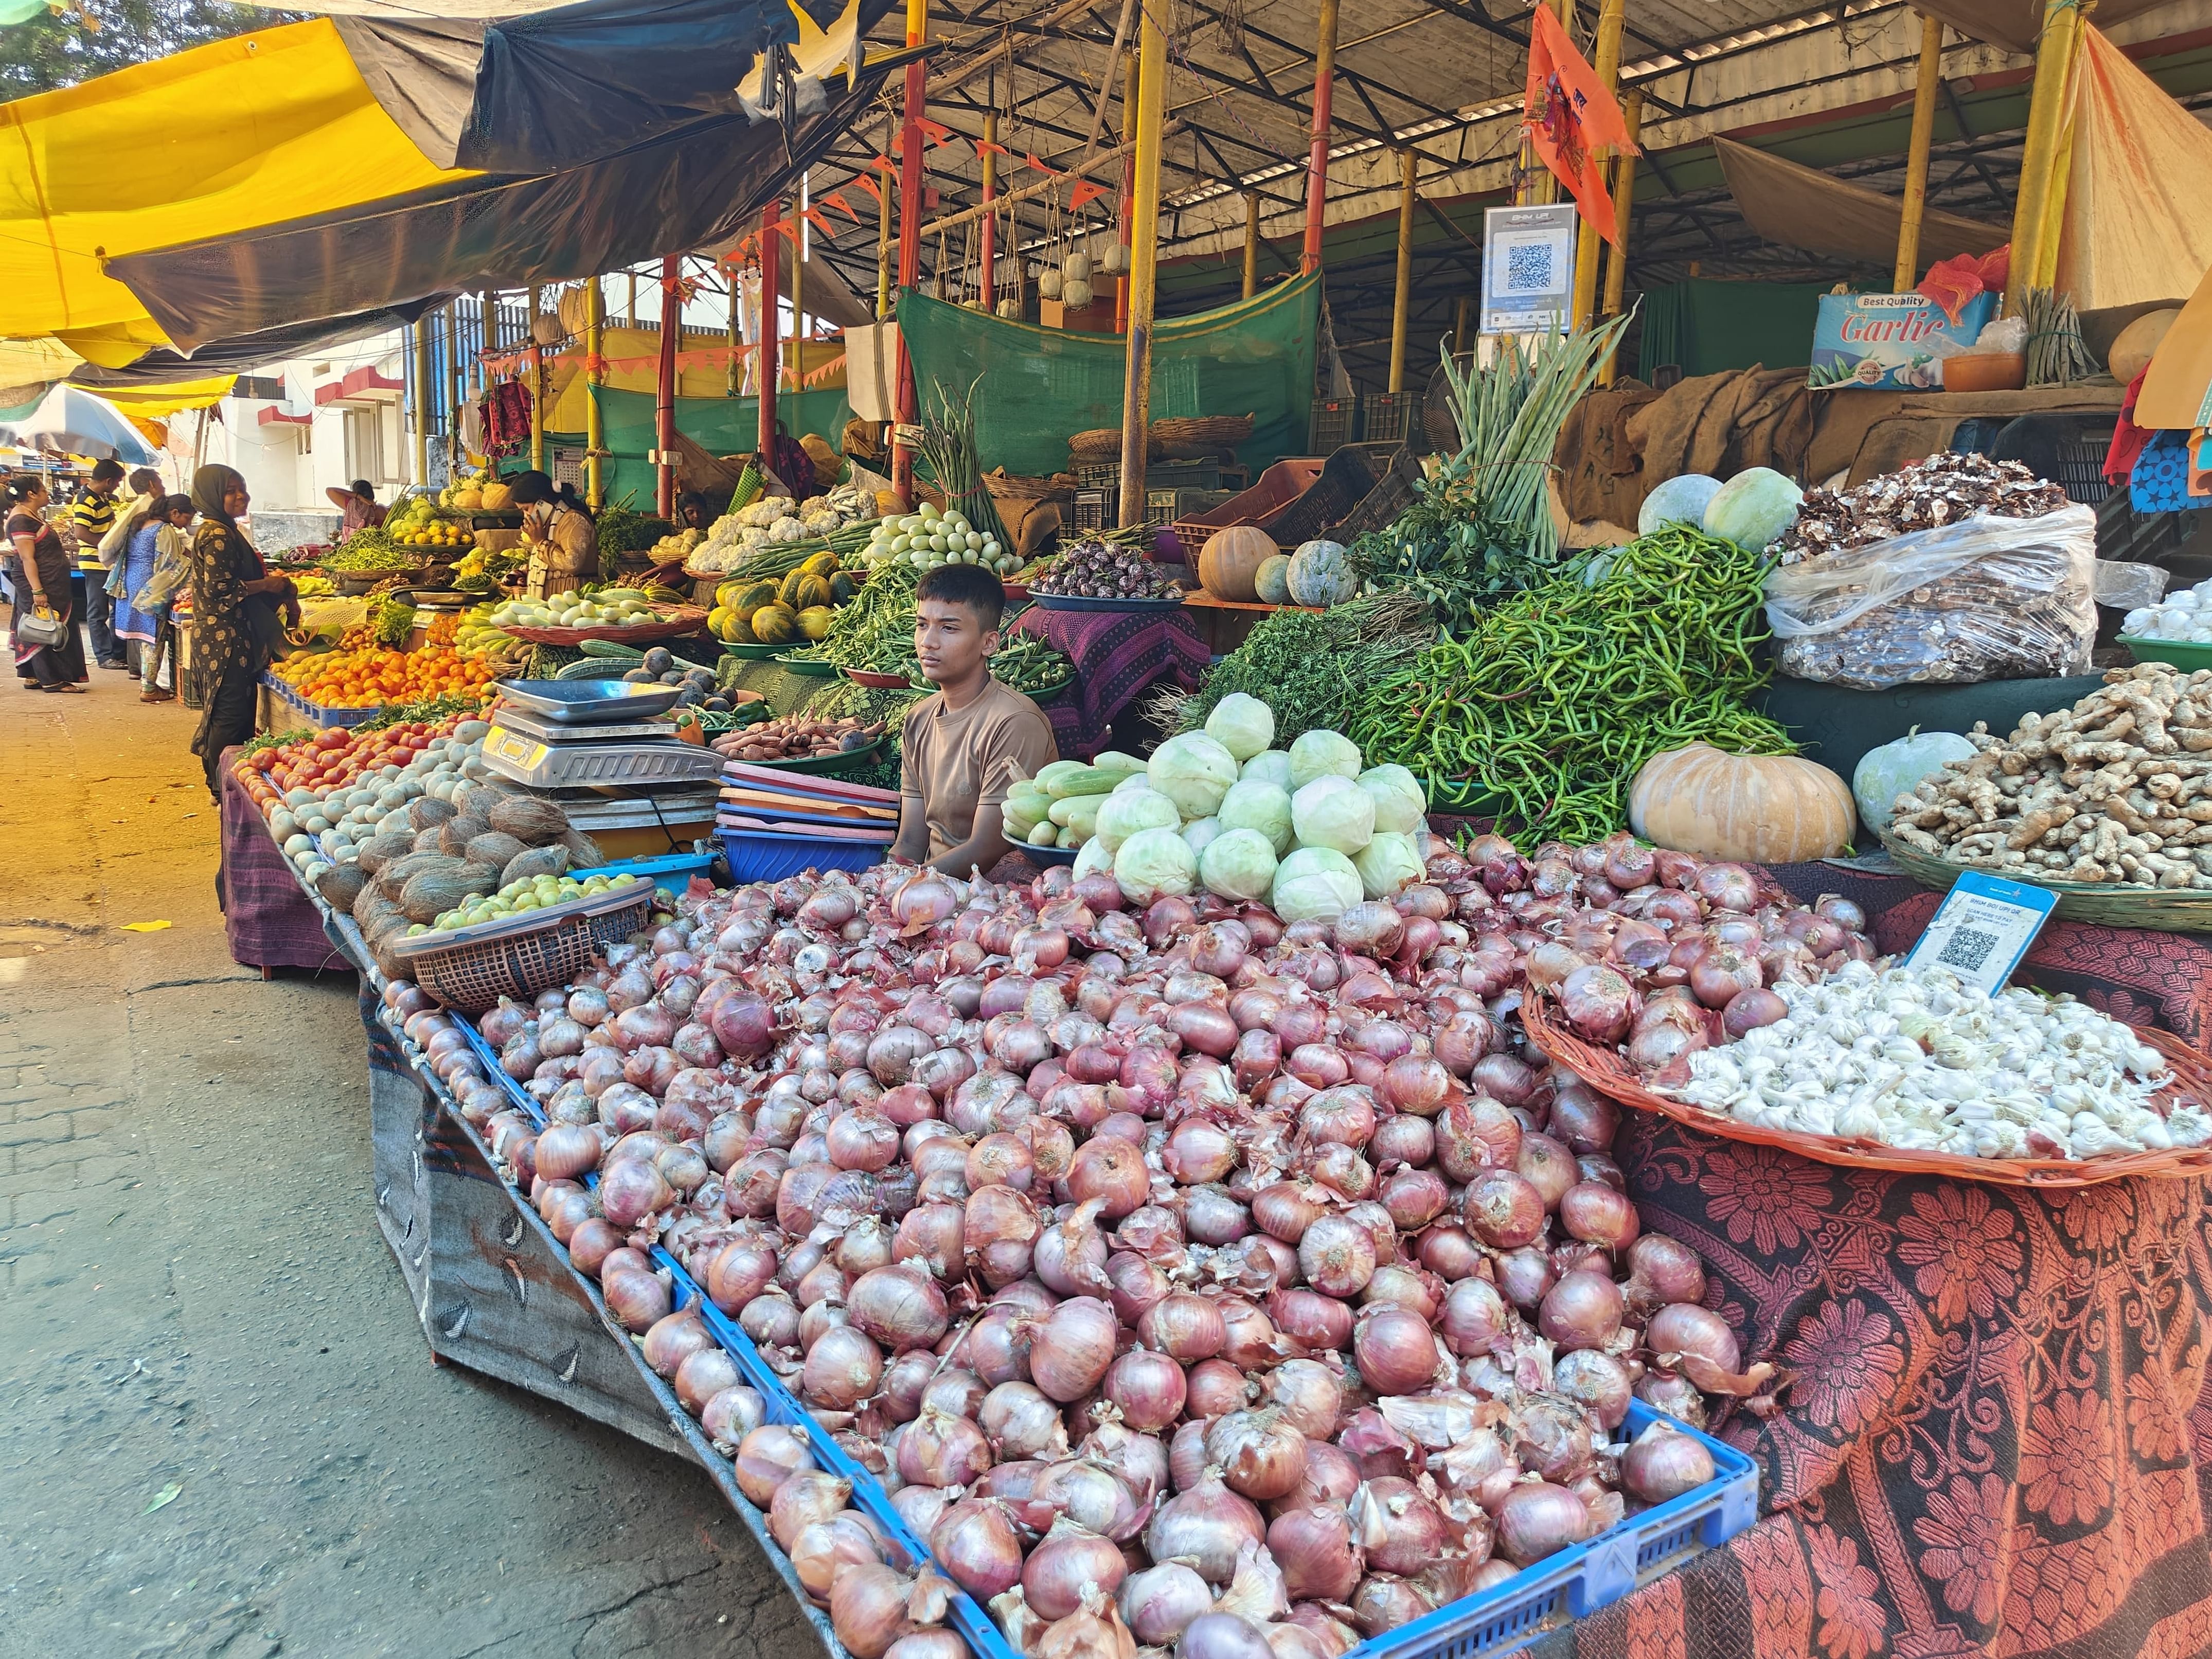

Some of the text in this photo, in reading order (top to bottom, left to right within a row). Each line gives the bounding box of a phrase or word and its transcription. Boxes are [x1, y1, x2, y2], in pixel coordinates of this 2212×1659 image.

[1887, 296, 1924, 306] Quality
[1841, 311, 1944, 343] Garlic
[1970, 898, 1987, 906] BHIM
